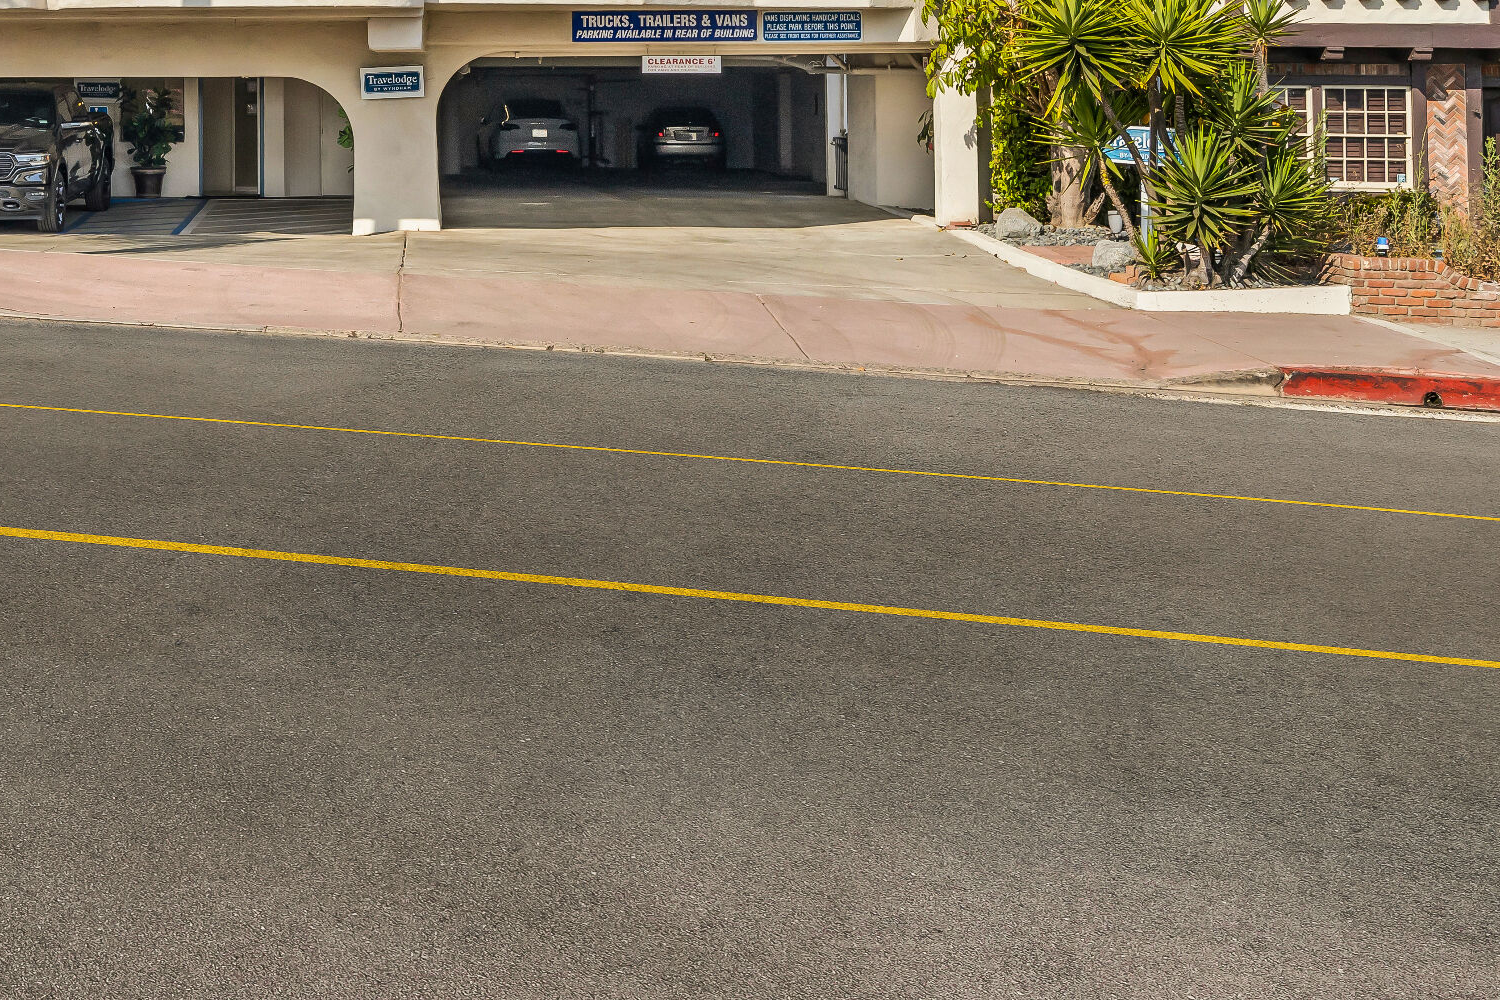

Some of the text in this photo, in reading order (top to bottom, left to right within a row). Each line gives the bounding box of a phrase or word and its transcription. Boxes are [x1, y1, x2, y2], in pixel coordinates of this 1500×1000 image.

[580, 14, 748, 29] TRUCKS, TRAILERS & VANS
[780, 14, 810, 22] DISPLAYING
[840, 13, 860, 21] DECALS
[766, 23, 787, 31] PLEASE
[788, 23, 802, 31] PARK
[804, 23, 825, 31] BEFORE
[827, 22, 839, 30] THIS
[576, 29, 755, 39] PARKING AVAILABLE IN REAR OF BUILDING
[366, 74, 418, 86] Travelodge
